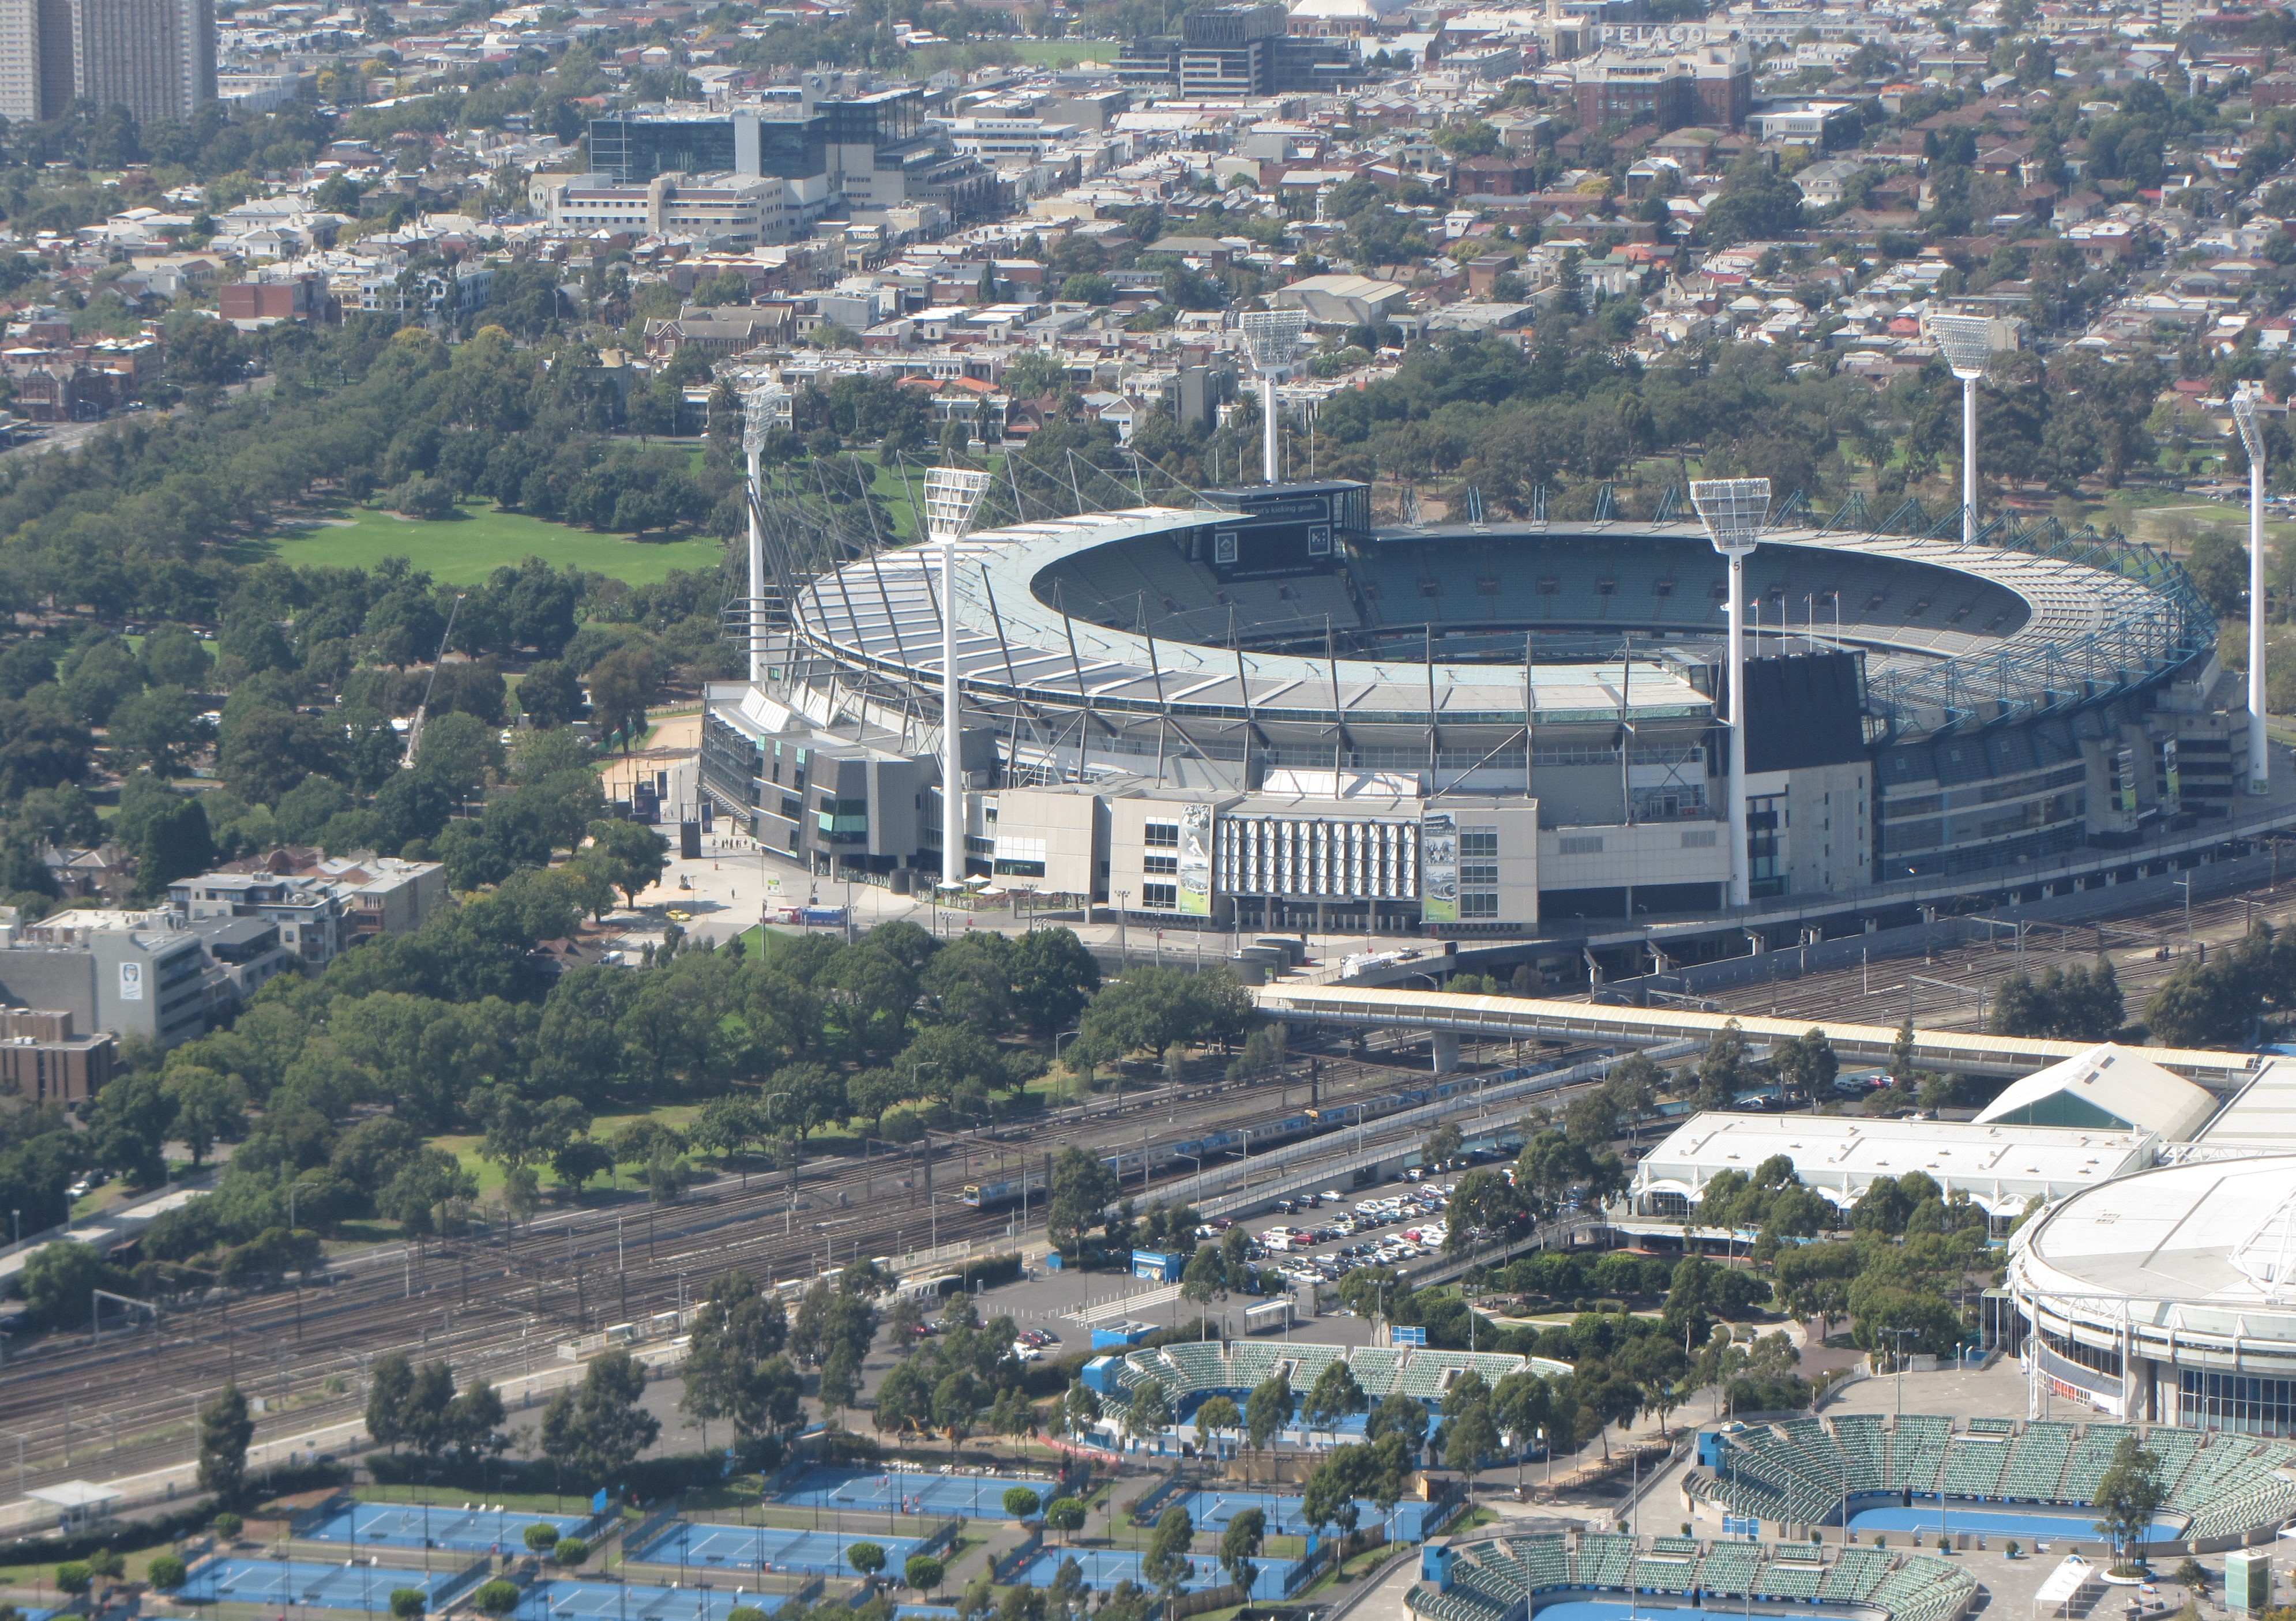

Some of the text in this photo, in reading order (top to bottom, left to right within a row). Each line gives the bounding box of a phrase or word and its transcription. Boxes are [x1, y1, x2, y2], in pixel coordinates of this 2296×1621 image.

[1600, 25, 1704, 42] PELACO
[852, 231, 879, 239] Vlado's
[1269, 378, 1275, 386] 2
[1964, 383, 1970, 393] 3
[1271, 505, 1296, 514] kicking
[1298, 503, 1317, 513] goals
[1734, 561, 1740, 571] 5
